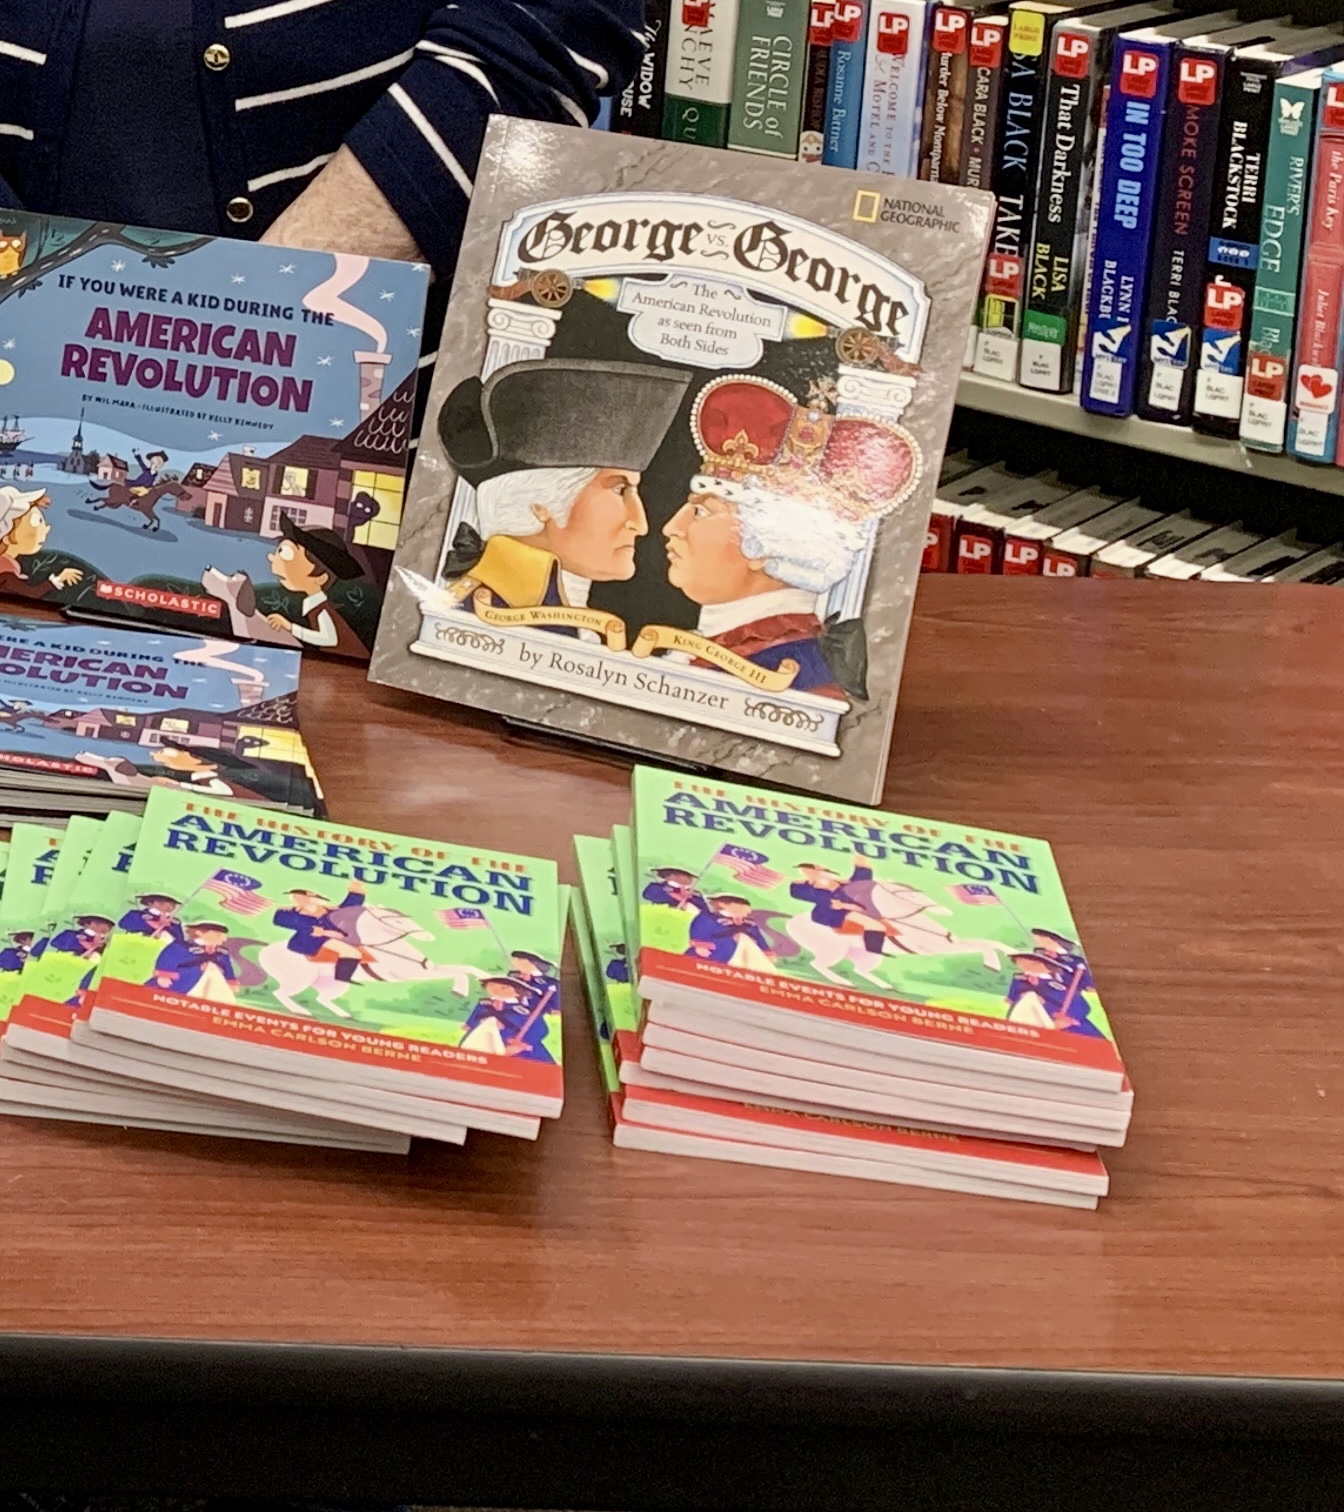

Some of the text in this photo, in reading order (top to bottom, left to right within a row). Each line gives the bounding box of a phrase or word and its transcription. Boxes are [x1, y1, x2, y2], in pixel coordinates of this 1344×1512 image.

[743, 35, 763, 130] FRIENDS
[766, 36, 793, 139] CIRCLE of
[1047, 83, 1081, 225] That Darkness
[1112, 100, 1151, 230] IN TOO DEEP
[1222, 120, 1248, 230] BLACKSTOCK
[1242, 152, 1261, 205] TERRI
[880, 210, 961, 233] GEOGRAPHIC
[883, 198, 945, 218] NATIONAL
[58, 274, 336, 326] IF YOU WERE A KID DURING THE
[517, 211, 704, 263] George
[732, 220, 911, 336] George
[692, 283, 718, 299] The
[84, 307, 296, 367] AMERICAN
[631, 292, 772, 328] American Revolution
[658, 319, 738, 340] as seen from
[661, 333, 730, 357] Both Sides
[61, 344, 314, 413] REVOLUTION
[114, 587, 218, 614] SCHOLASTIC
[530, 610, 602, 626] WASHINGTON
[519, 643, 729, 709] by Rosalyn Schanzer
[673, 634, 702, 653] KING
[749, 669, 767, 684] III
[172, 814, 534, 891] AMERICAN
[663, 792, 1031, 870] AMERICAN
[663, 806, 1040, 894] REVOLUTION
[164, 830, 534, 916] REVOLUTION
